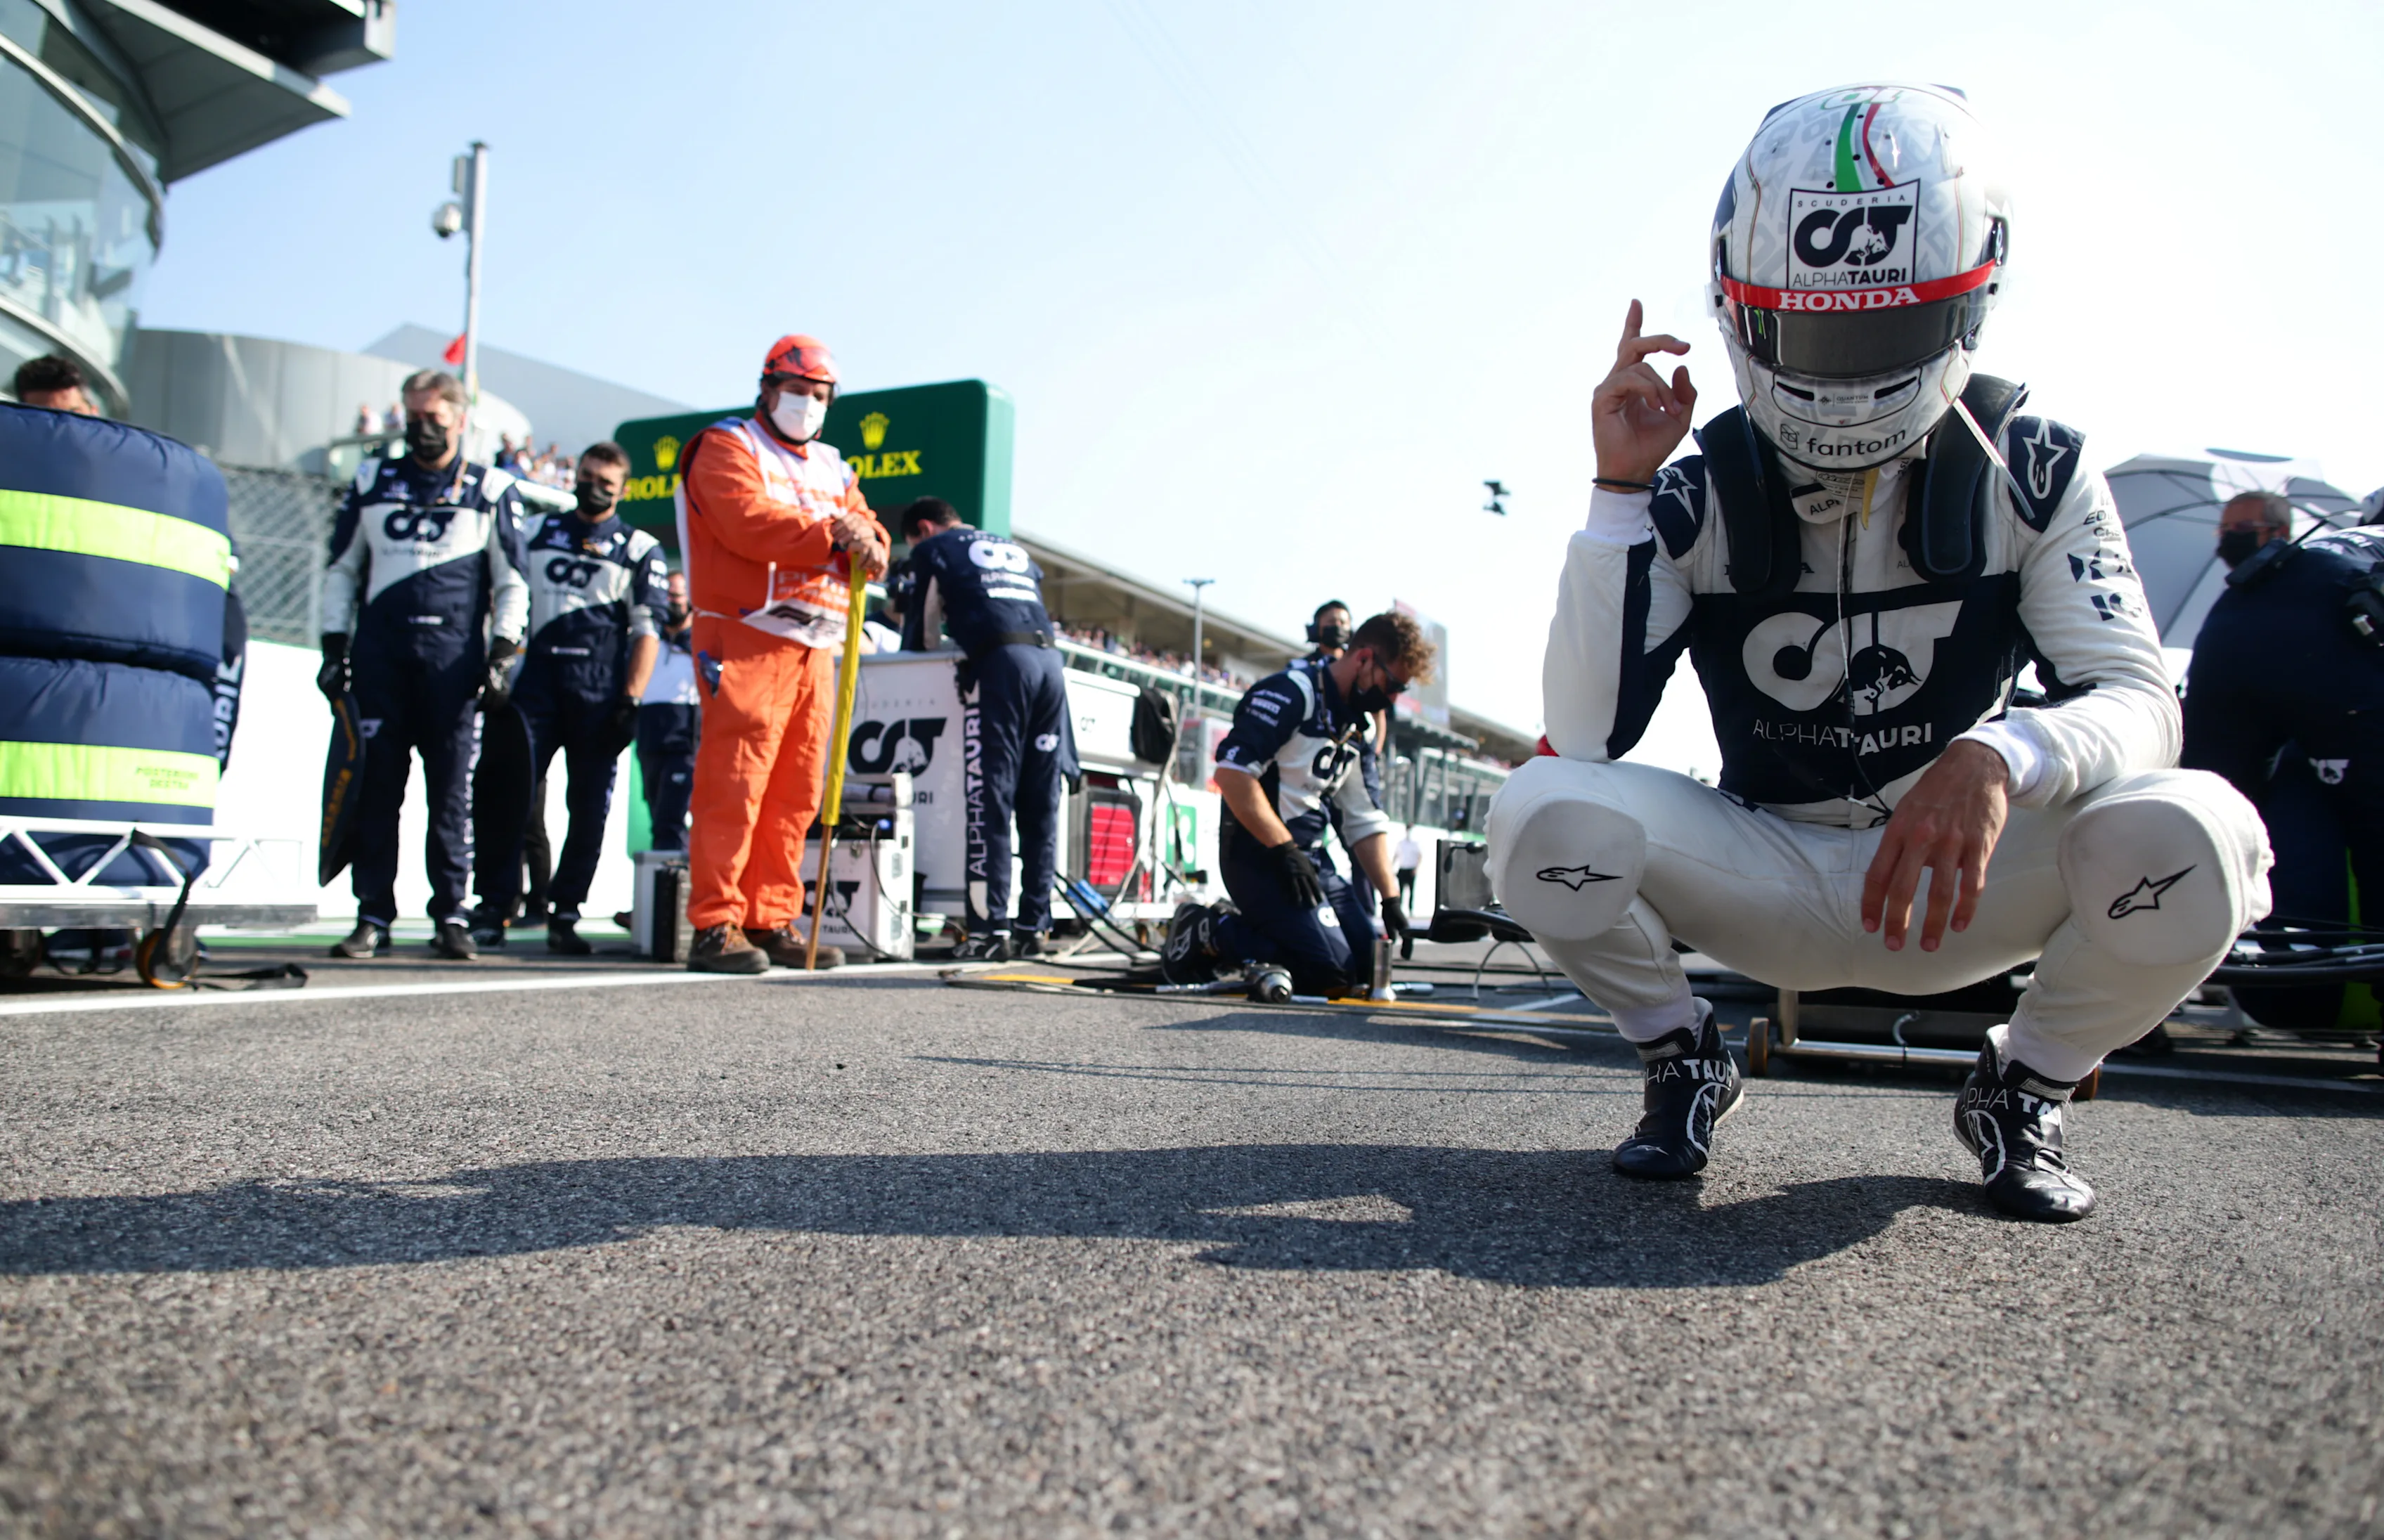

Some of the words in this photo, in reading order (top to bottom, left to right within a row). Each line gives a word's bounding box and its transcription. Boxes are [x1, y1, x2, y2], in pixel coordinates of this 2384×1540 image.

[1797, 195, 1905, 208] SCUDERIA
[1792, 268, 1907, 287] ALPHATAURI
[1778, 287, 1920, 311] HONDA
[1807, 429, 1906, 456] fantom
[846, 450, 922, 479] OLEX
[1753, 719, 1932, 756] ALPHATAURI
